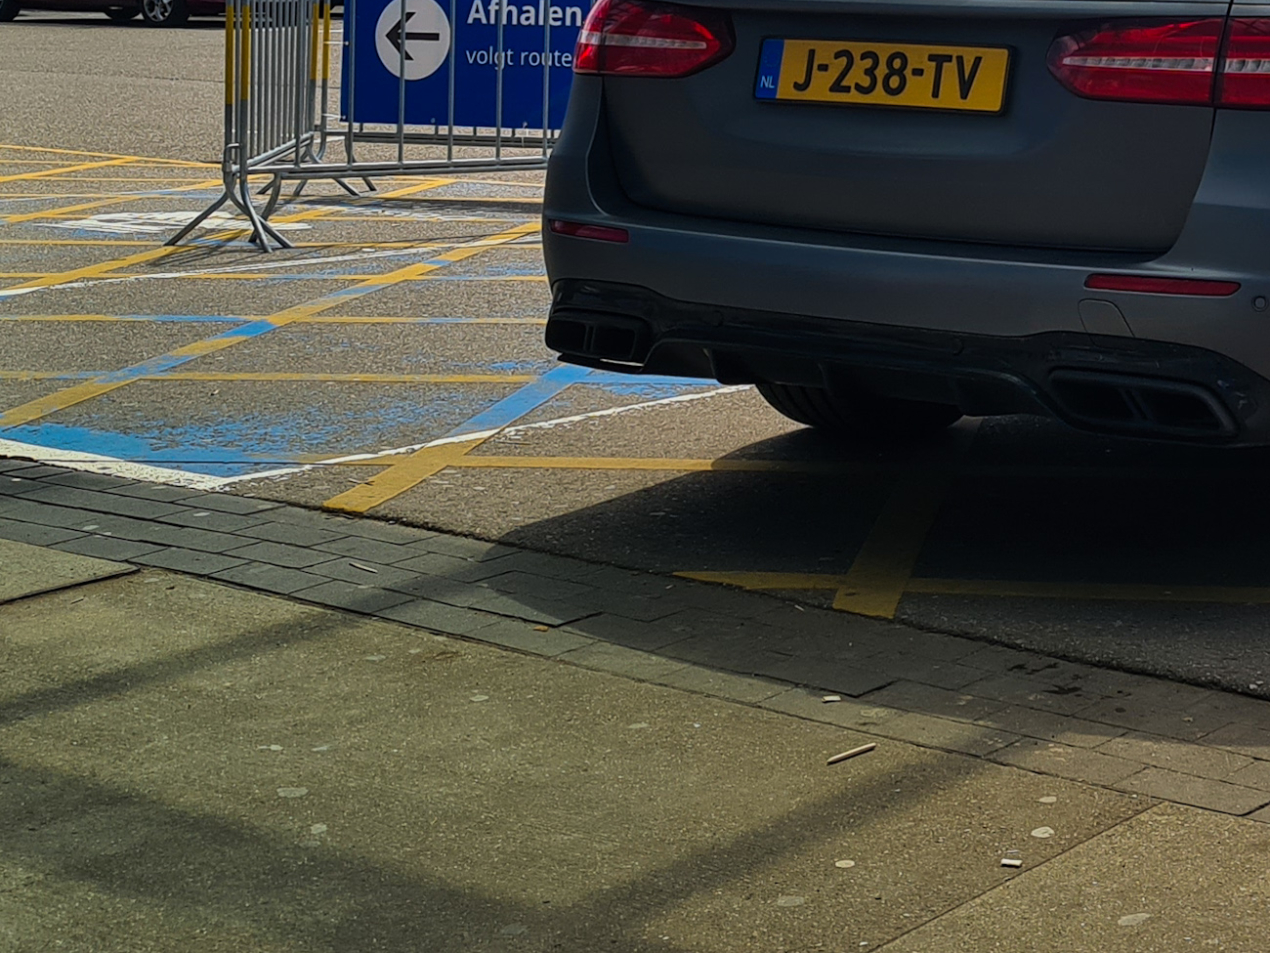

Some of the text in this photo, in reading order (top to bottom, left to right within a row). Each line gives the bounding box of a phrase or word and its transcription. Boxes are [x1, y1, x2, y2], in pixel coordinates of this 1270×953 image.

[466, 46, 573, 71] volgt route
[760, 75, 775, 89] NL
[793, 49, 983, 101] J-238-TV
